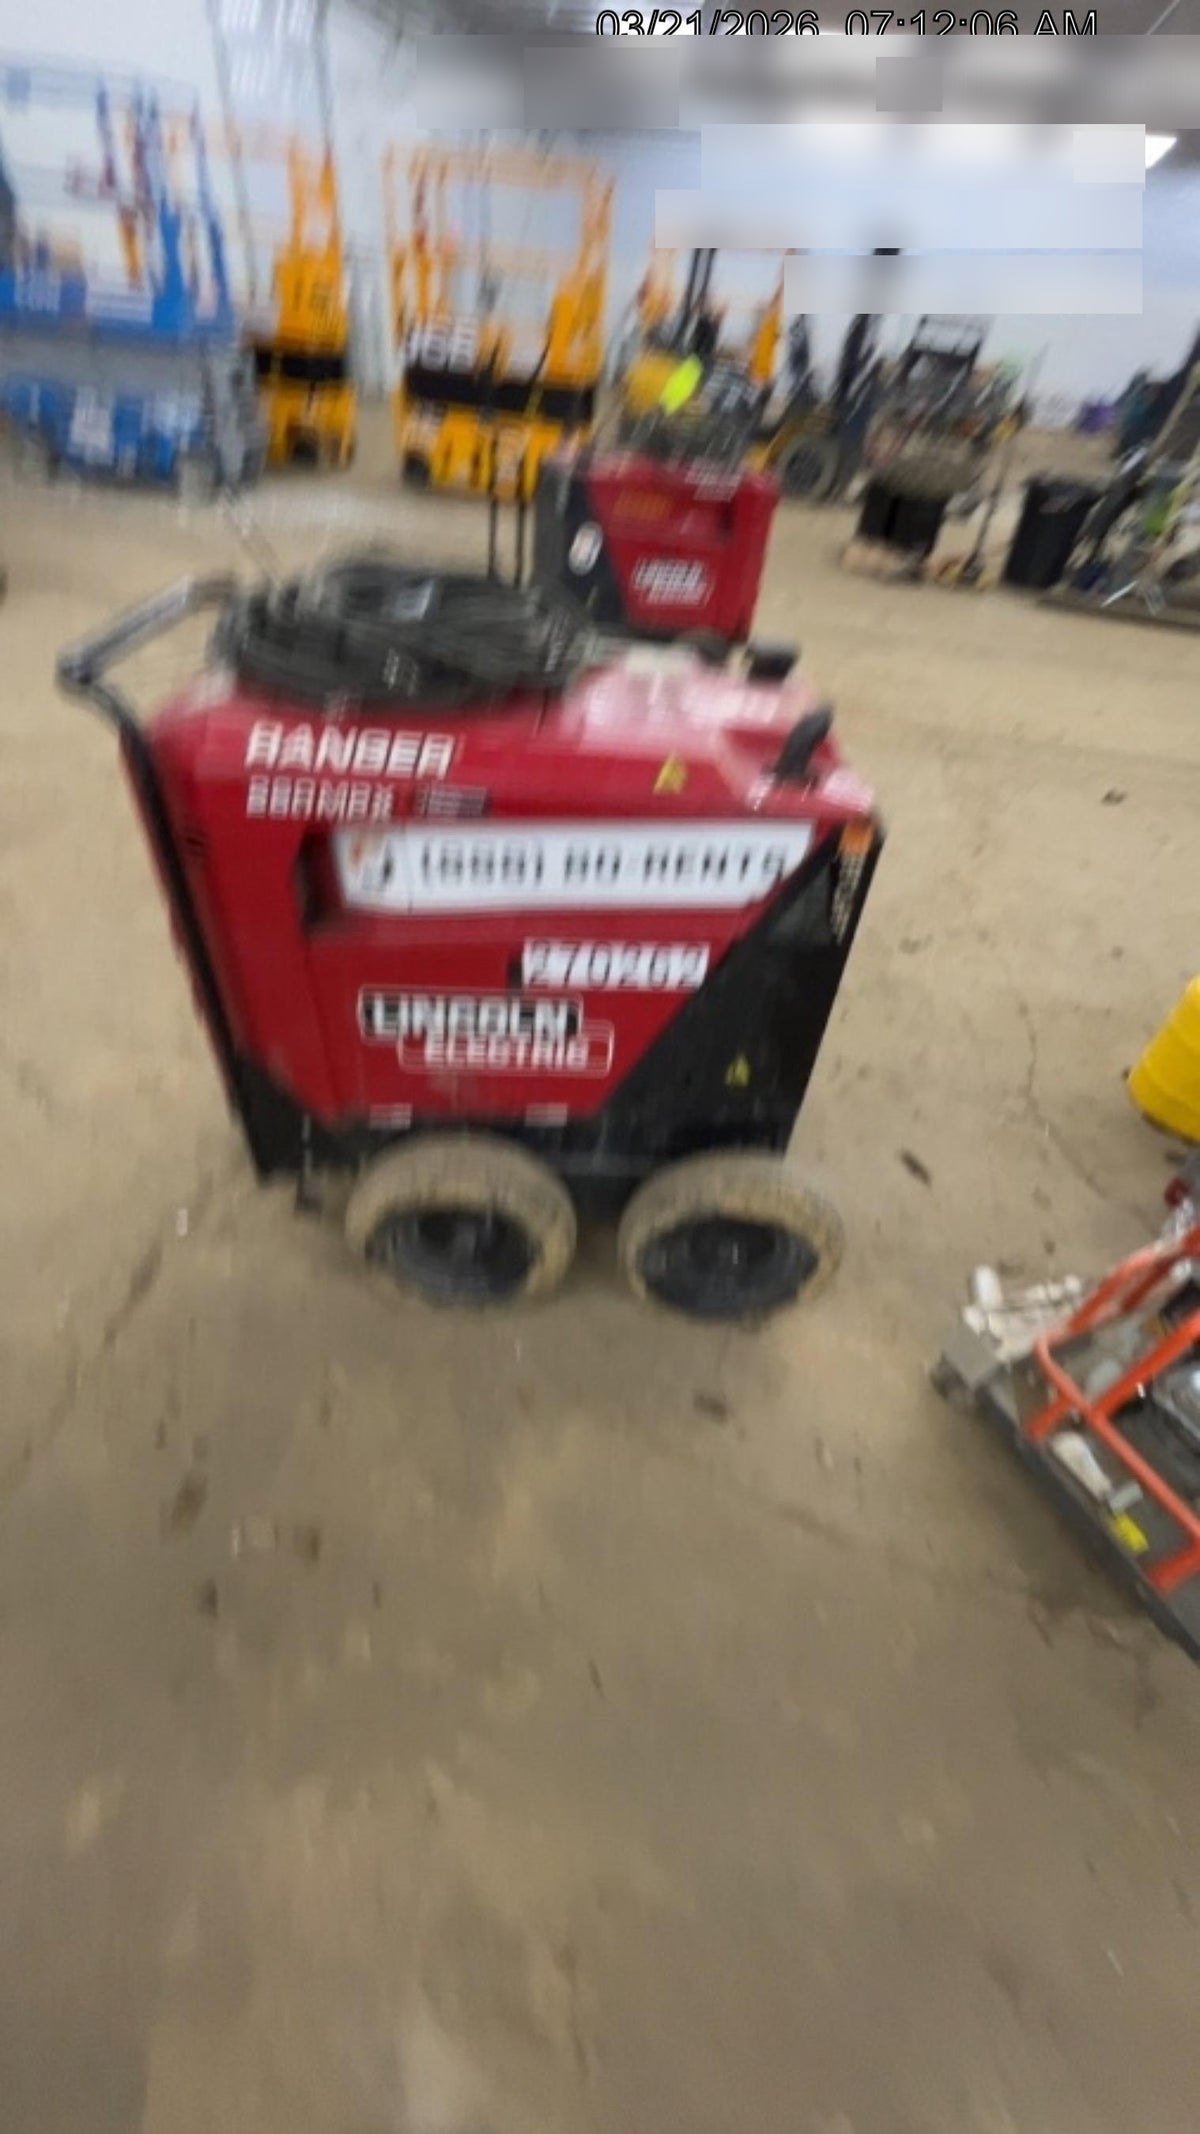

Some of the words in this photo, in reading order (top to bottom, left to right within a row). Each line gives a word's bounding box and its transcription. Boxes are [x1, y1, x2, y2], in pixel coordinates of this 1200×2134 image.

[245, 720, 456, 780] RANGER
[372, 992, 569, 1040] LINCOLN
[424, 1034, 590, 1071] ELECTRIC
